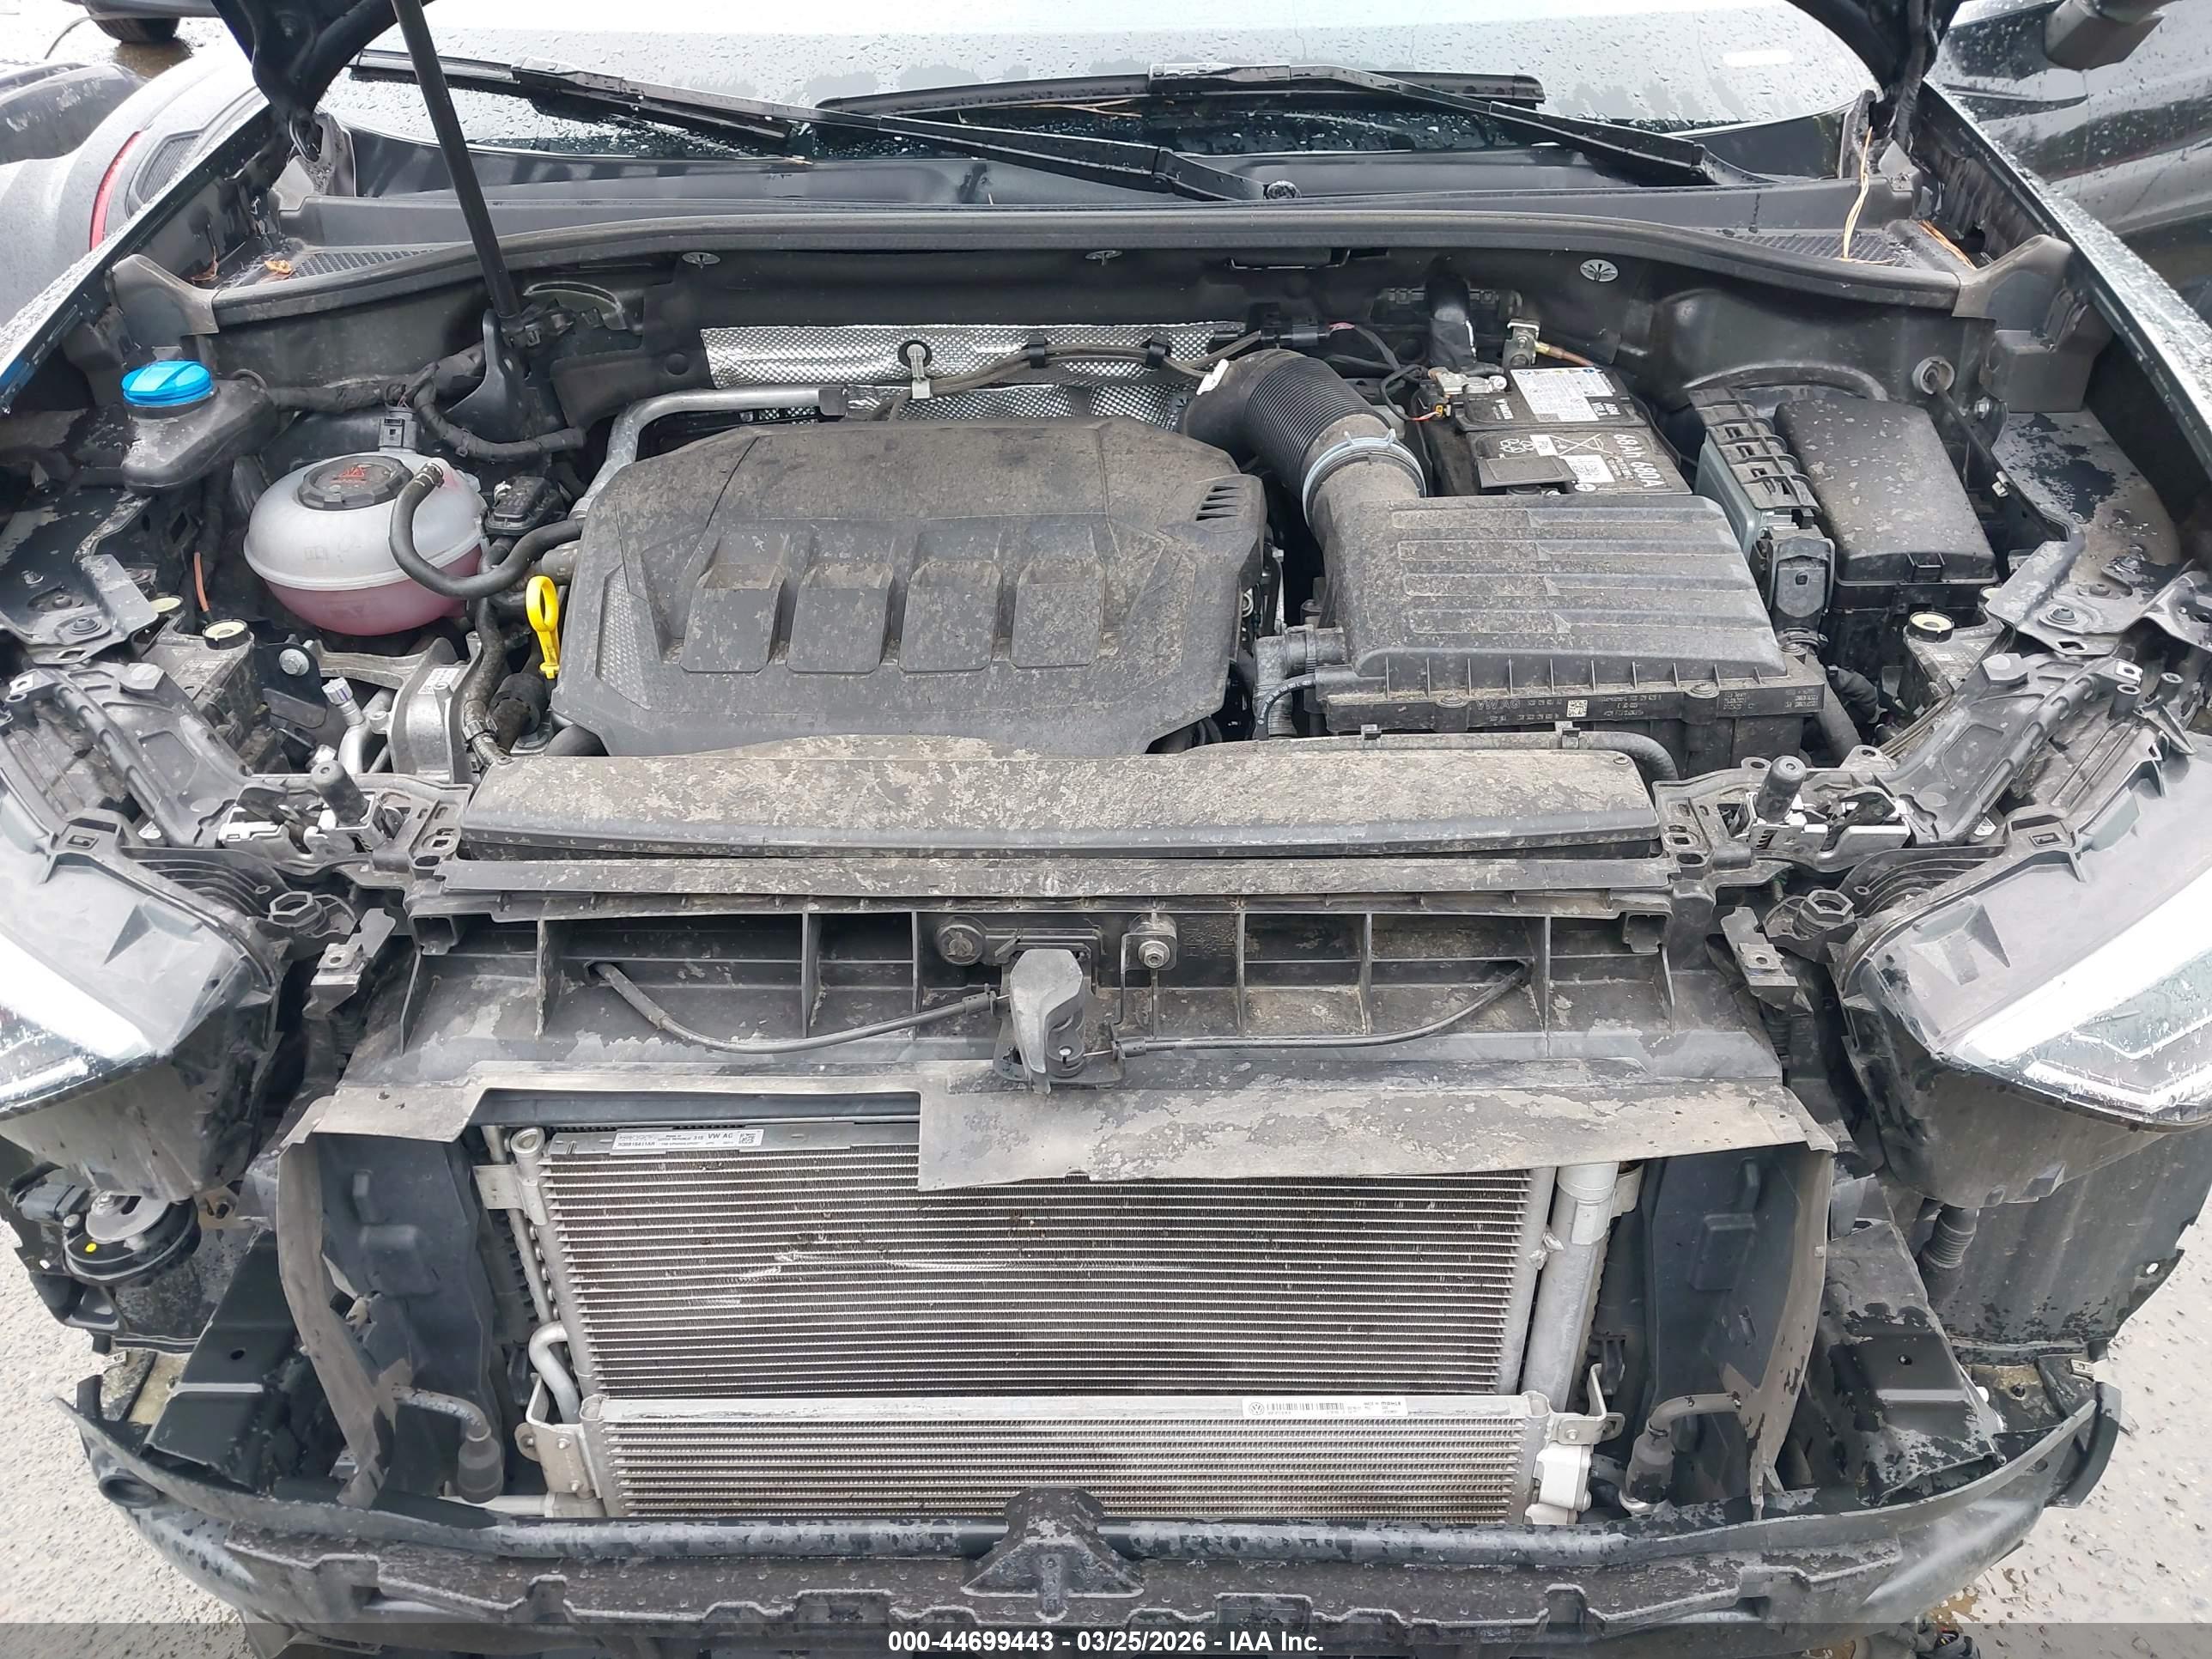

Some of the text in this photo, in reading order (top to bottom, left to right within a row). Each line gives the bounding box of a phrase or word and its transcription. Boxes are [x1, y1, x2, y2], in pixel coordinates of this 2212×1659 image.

[1602, 403, 1621, 416] AGM
[1613, 434, 1646, 459] 68Ah
[1630, 461, 1666, 488] 680A
[1476, 699, 1498, 710] VW
[1499, 697, 1520, 709] AG
